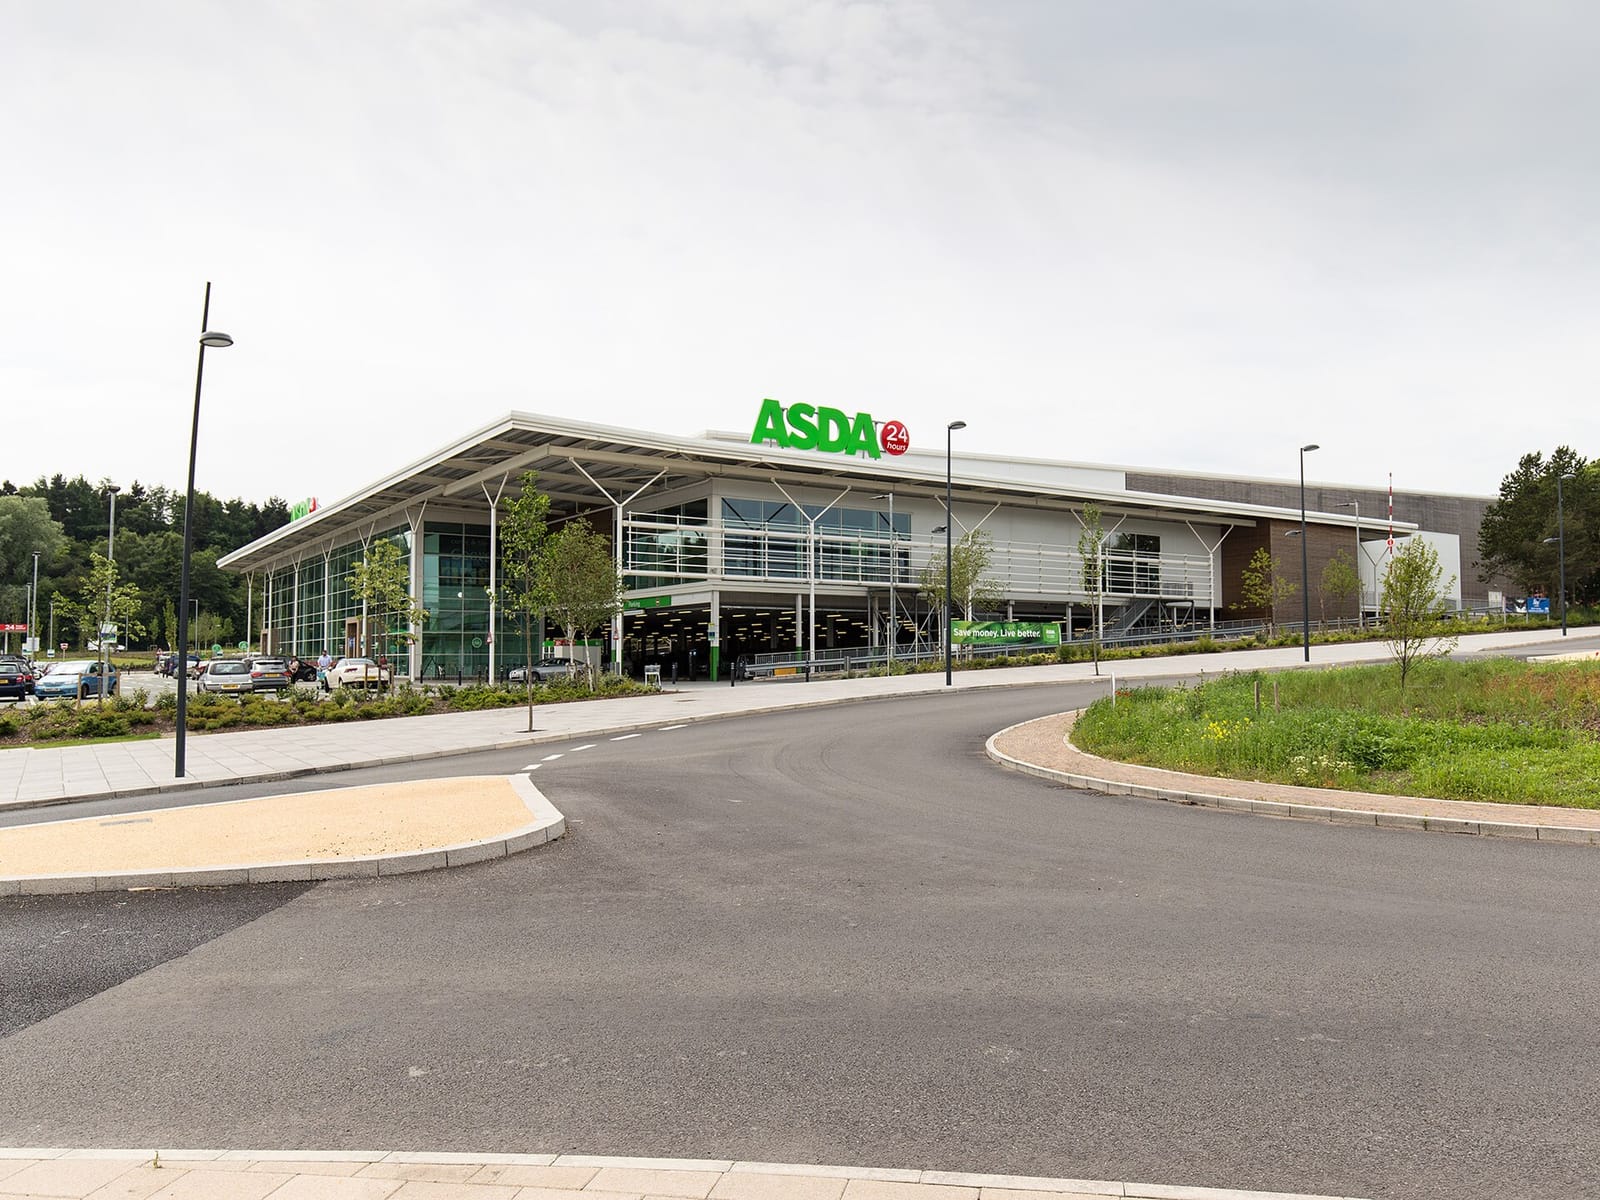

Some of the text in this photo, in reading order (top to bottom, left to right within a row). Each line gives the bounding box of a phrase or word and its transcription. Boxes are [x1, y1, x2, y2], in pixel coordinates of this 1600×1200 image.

[750, 398, 881, 460] ASDA
[886, 425, 908, 443] 24
[887, 441, 906, 451] hours
[953, 628, 972, 637] Save
[973, 629, 999, 639] money.
[1000, 629, 1016, 638] Live
[1017, 630, 1041, 639] better.
